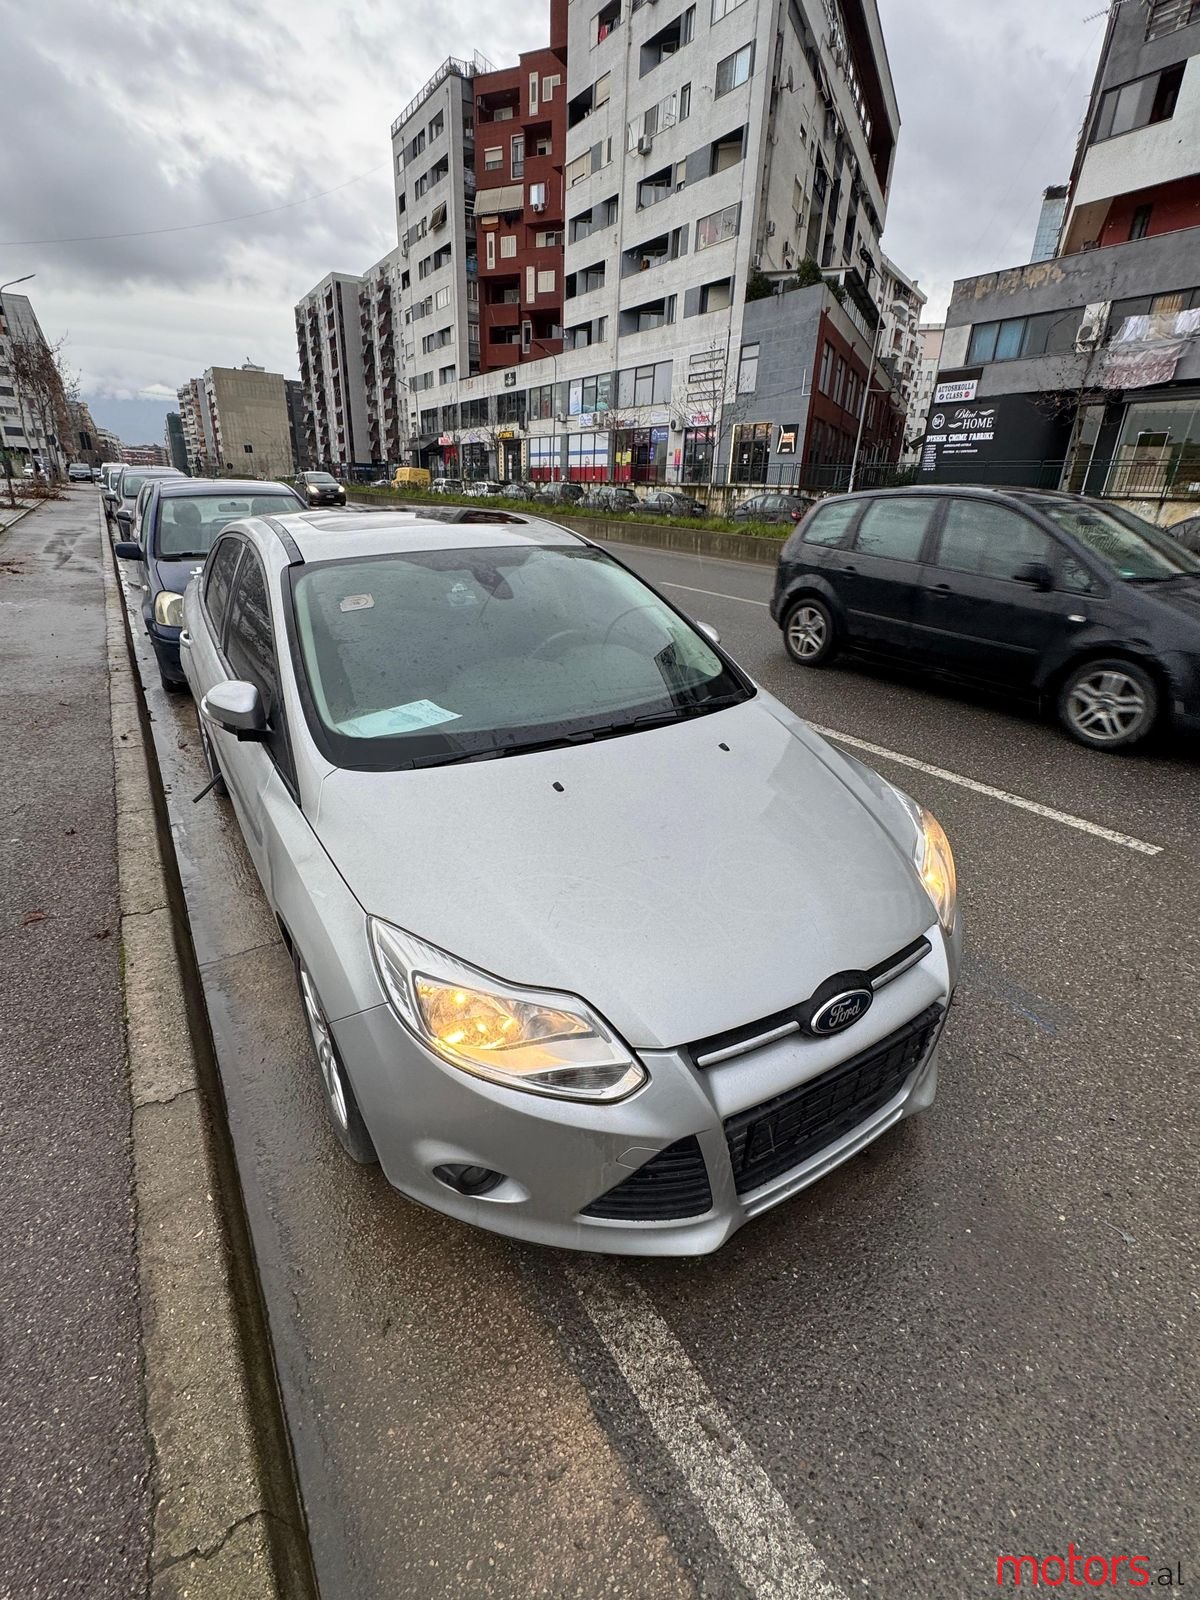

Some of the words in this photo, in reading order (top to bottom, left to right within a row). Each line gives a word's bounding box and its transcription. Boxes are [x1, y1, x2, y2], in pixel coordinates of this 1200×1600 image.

[945, 392, 963, 400] CLASS
[962, 417, 994, 429] HOME
[828, 998, 861, 1028] Ford
